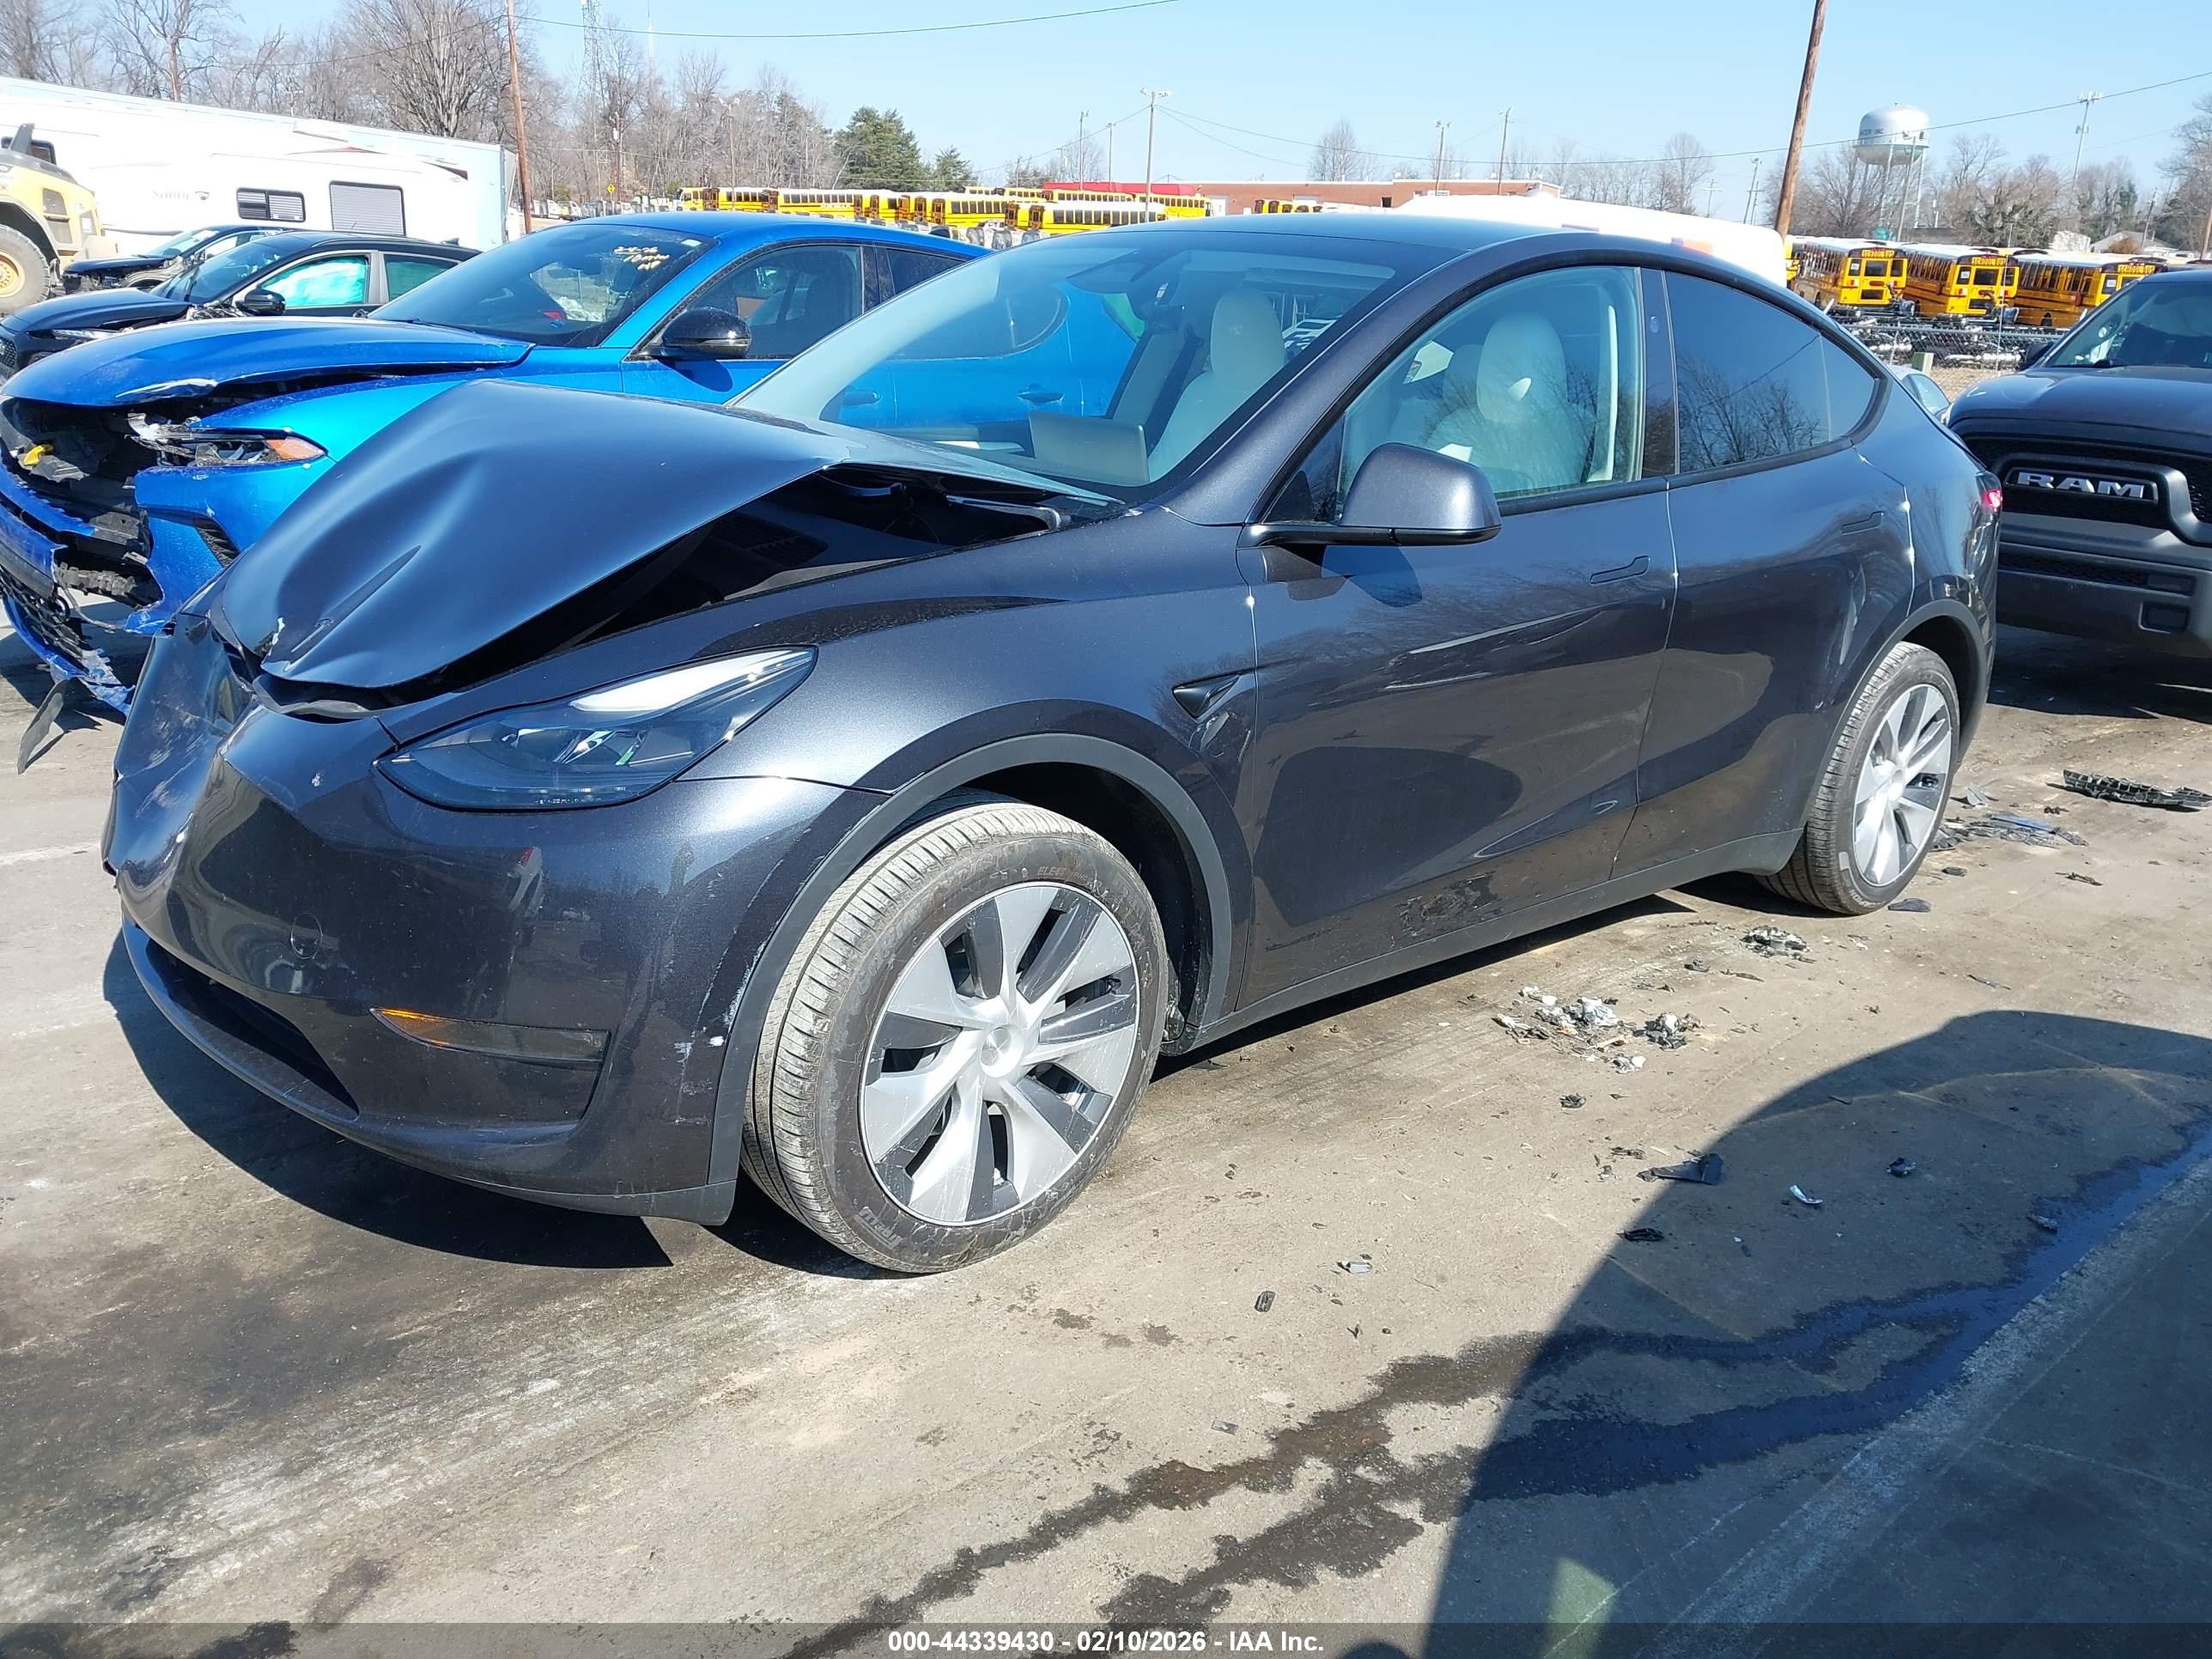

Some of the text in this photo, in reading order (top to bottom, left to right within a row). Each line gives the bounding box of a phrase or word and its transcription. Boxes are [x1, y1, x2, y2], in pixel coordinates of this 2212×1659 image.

[2119, 264, 2143, 273] SCHOOL
[2017, 471, 2144, 499] RAM
[853, 1206, 903, 1250] PIRELLI
